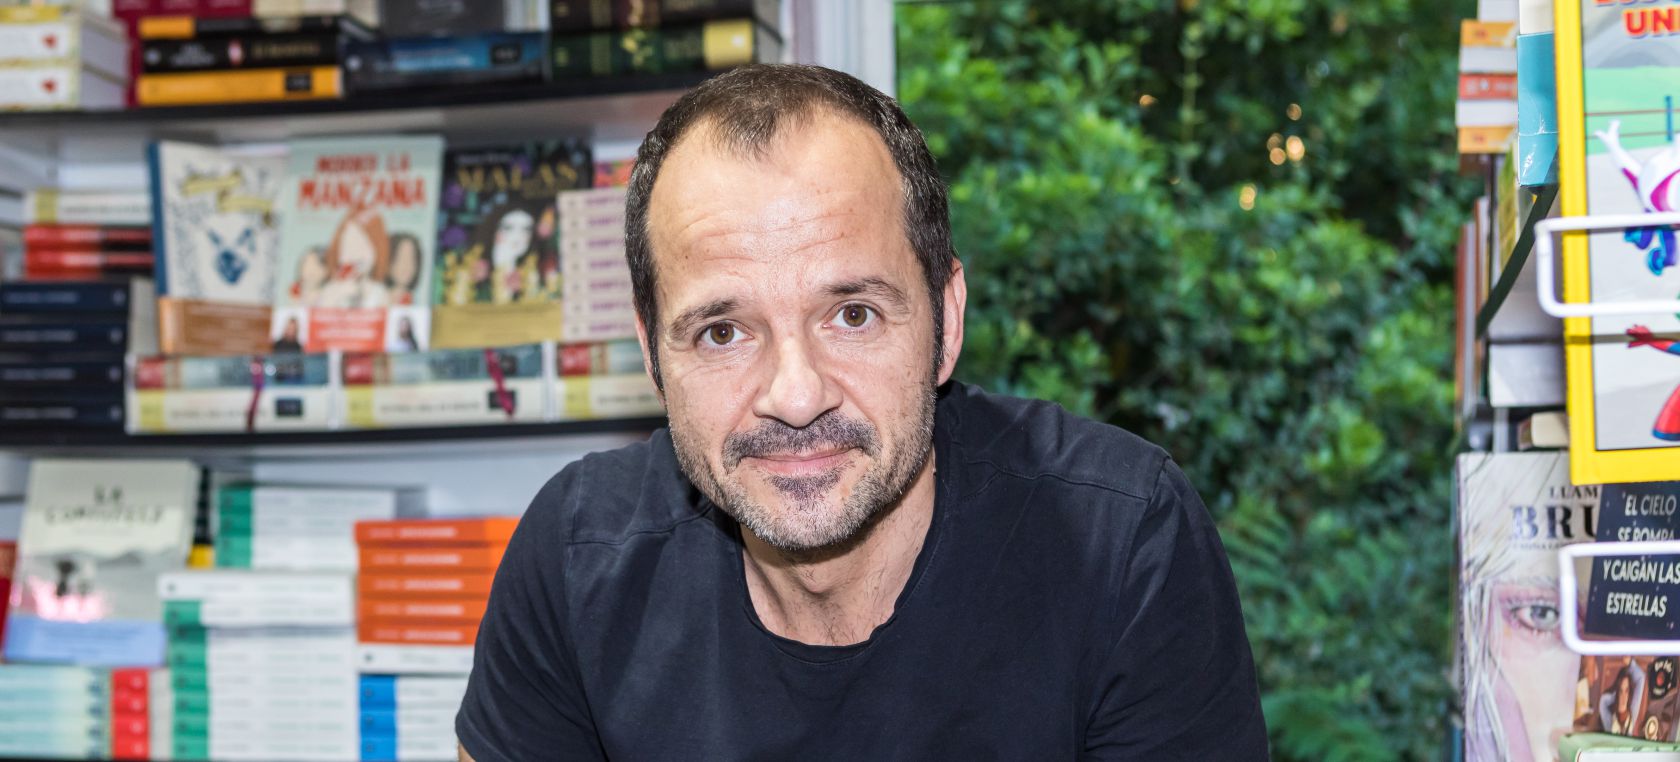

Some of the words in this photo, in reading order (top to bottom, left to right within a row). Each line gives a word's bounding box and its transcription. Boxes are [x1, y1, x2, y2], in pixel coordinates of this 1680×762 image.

[299, 176, 426, 208] MANZANA
[1624, 494, 1638, 516] EL
[1640, 493, 1677, 516] CIELO
[1603, 559, 1612, 581] Y
[1605, 591, 1668, 618] ESTRELLAS
